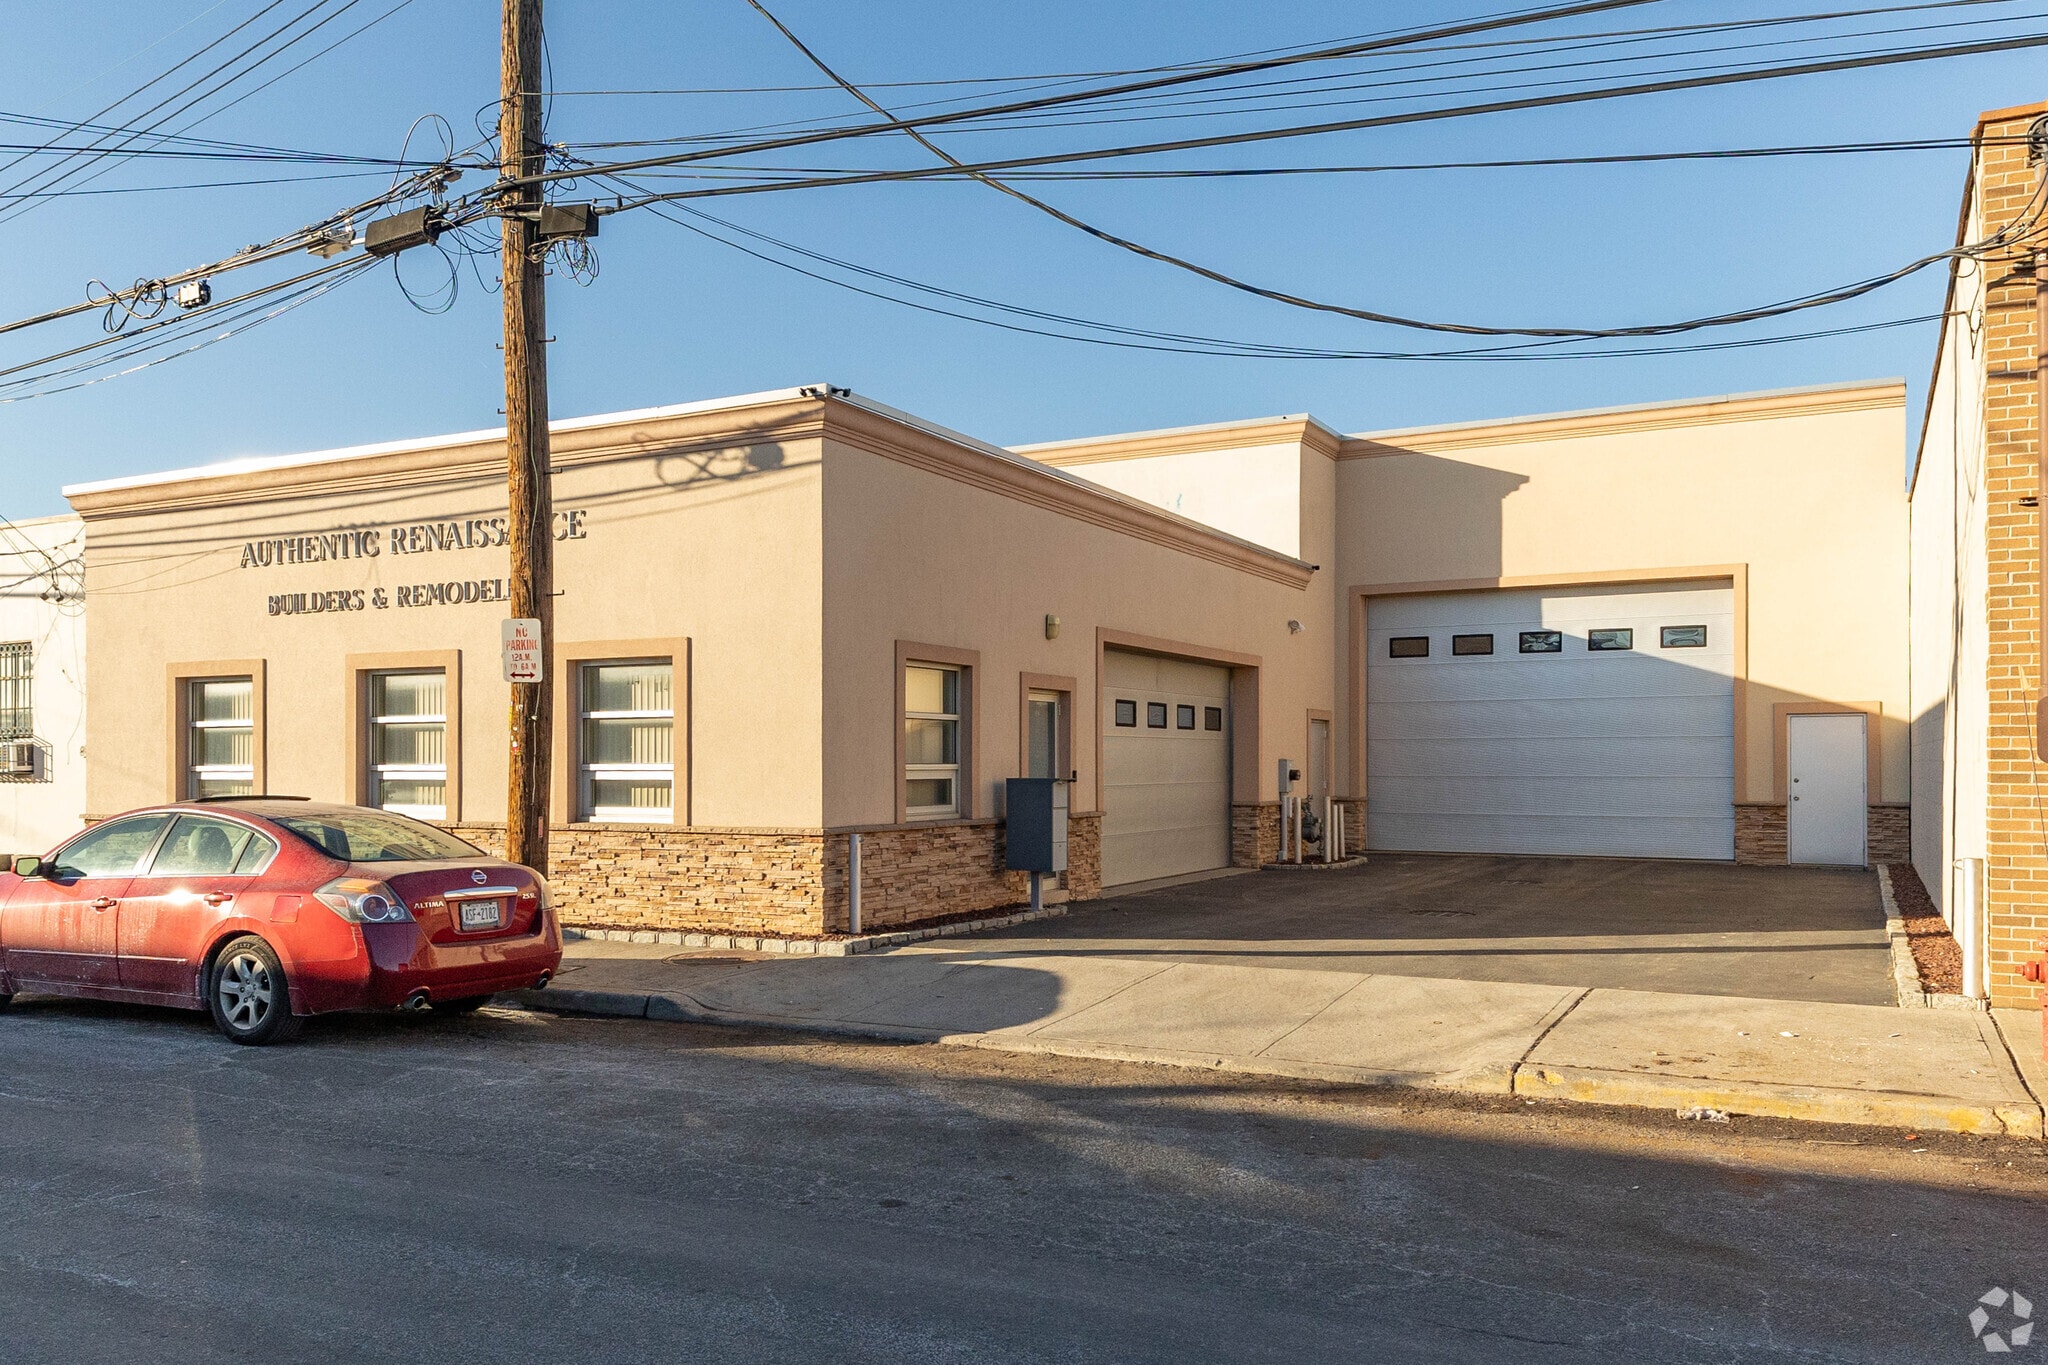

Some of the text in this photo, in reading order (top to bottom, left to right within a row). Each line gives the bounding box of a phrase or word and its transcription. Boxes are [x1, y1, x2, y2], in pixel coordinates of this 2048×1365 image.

[240, 510, 587, 568] AUTHENTIC RENAISSCE
[268, 578, 511, 616] BUILDERS & REMODEL
[413, 900, 445, 909] ALTIMA
